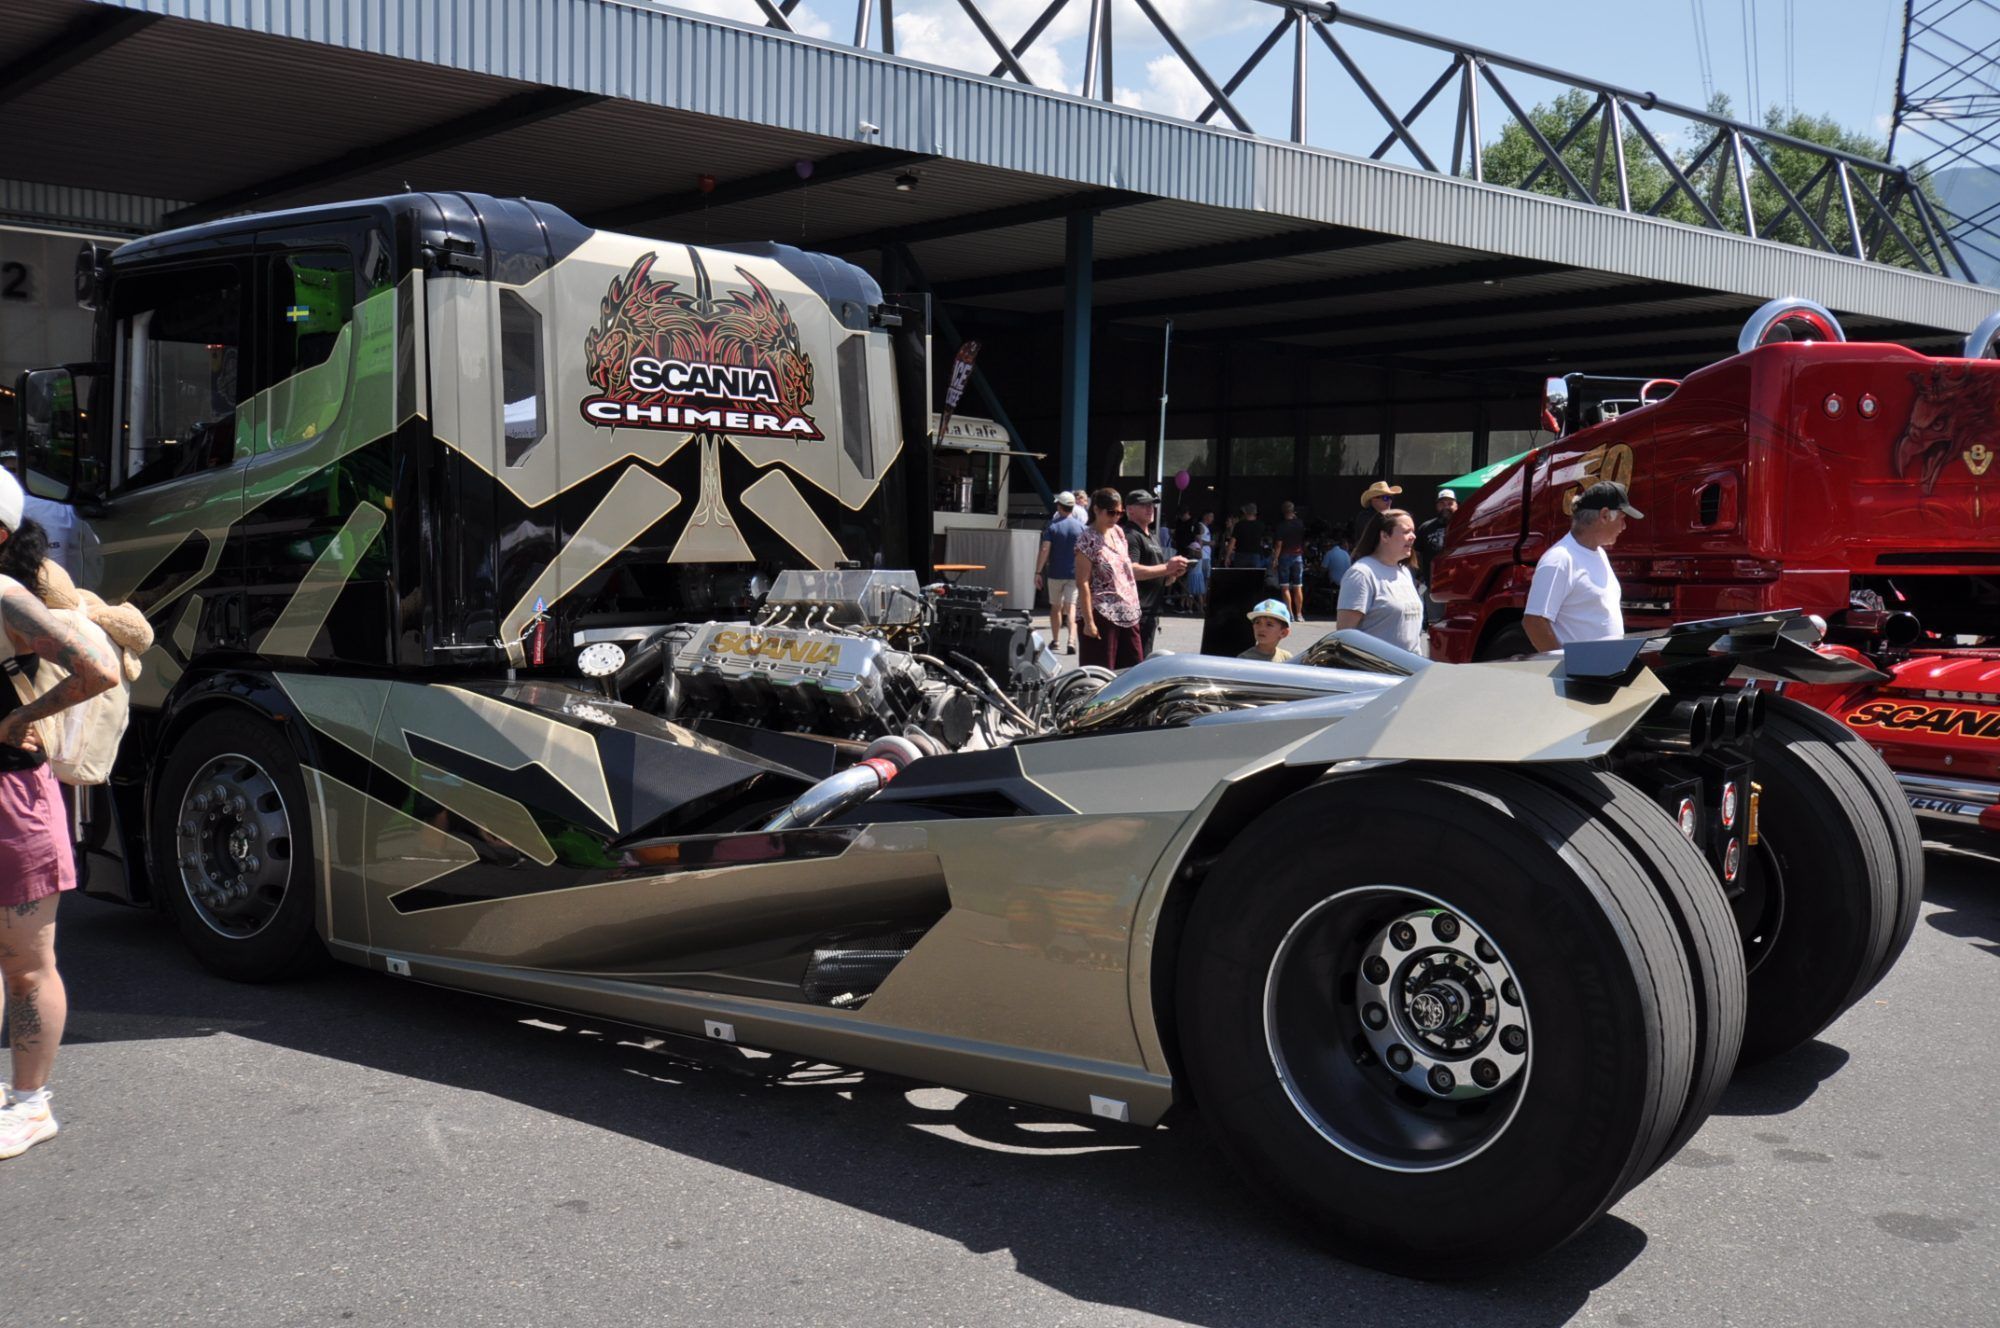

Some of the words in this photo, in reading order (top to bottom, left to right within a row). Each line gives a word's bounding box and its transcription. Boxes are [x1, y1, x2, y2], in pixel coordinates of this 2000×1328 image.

[3, 262, 27, 298] 2
[631, 357, 778, 403] SCANIA
[587, 402, 815, 434] CHIMERA
[708, 631, 842, 666] SCANIA
